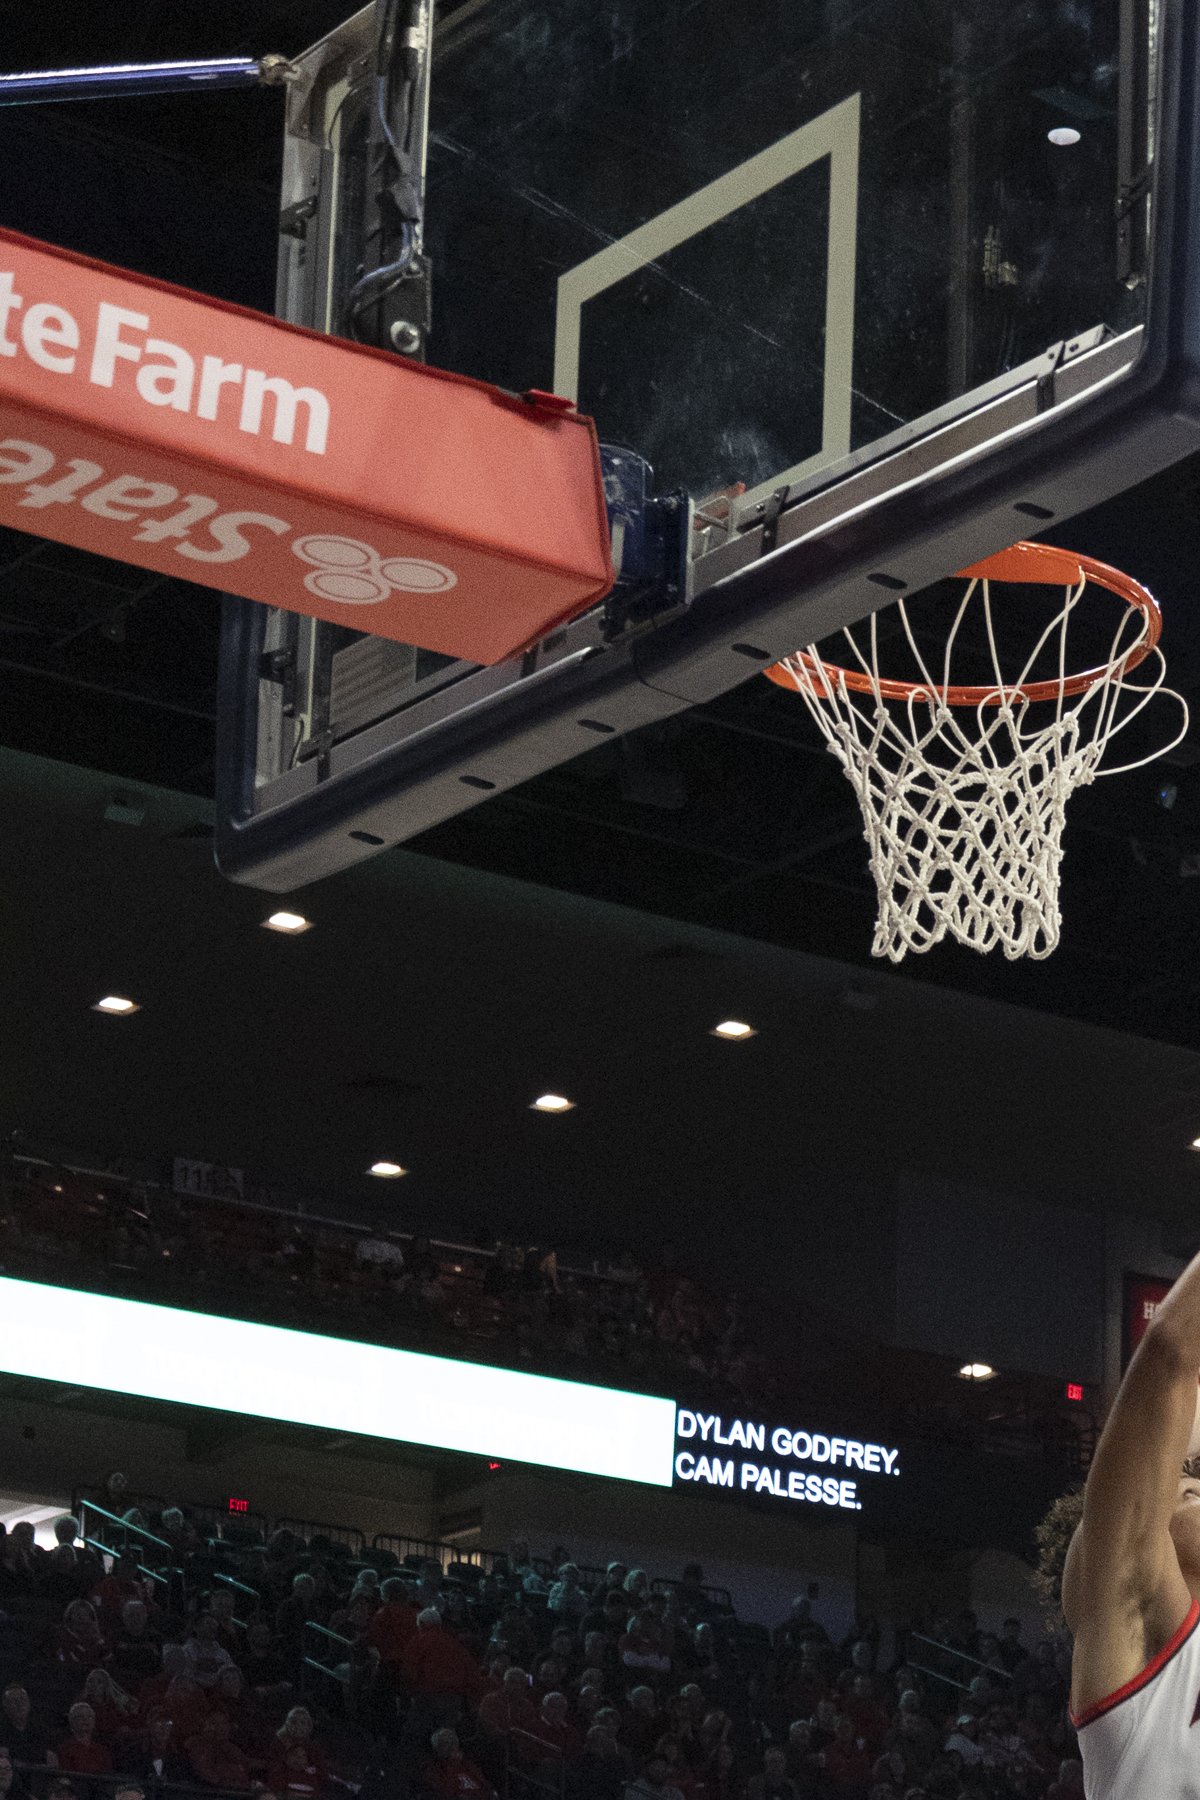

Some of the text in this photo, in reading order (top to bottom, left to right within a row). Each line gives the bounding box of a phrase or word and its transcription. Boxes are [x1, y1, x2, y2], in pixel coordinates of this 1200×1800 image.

[678, 1409, 765, 1451] DYLAN
[772, 1428, 900, 1476] GODFREY.
[675, 1452, 862, 1510] CAM PALESSE.
